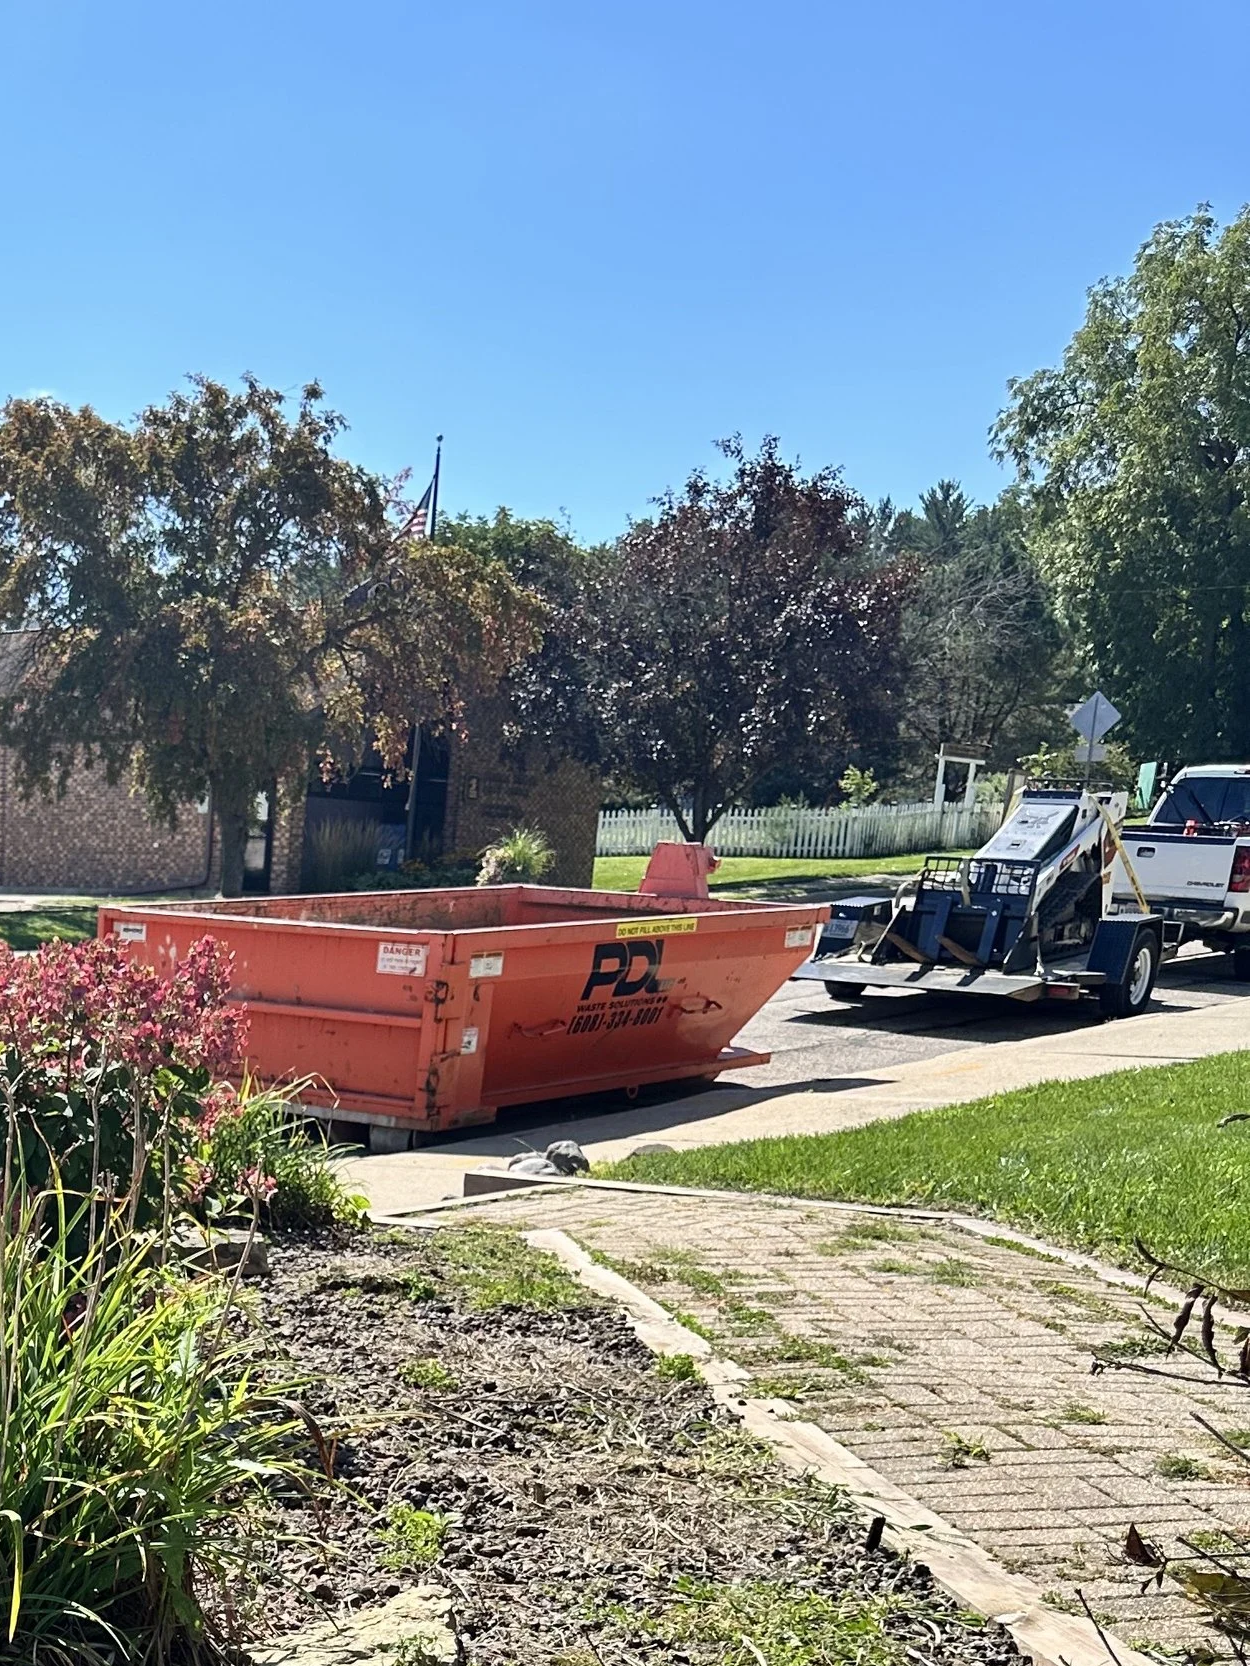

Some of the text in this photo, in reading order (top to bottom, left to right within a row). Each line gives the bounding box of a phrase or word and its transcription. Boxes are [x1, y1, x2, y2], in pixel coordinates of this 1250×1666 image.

[1186, 880, 1225, 888] CHEVROLET
[618, 922, 695, 936] DO NOT FILL ABOVE THIS LINE
[383, 946, 421, 957] DANGER
[580, 939, 671, 1001] PDL
[576, 1002, 607, 1013] WASTE
[608, 997, 656, 1009] SOLUTIONS
